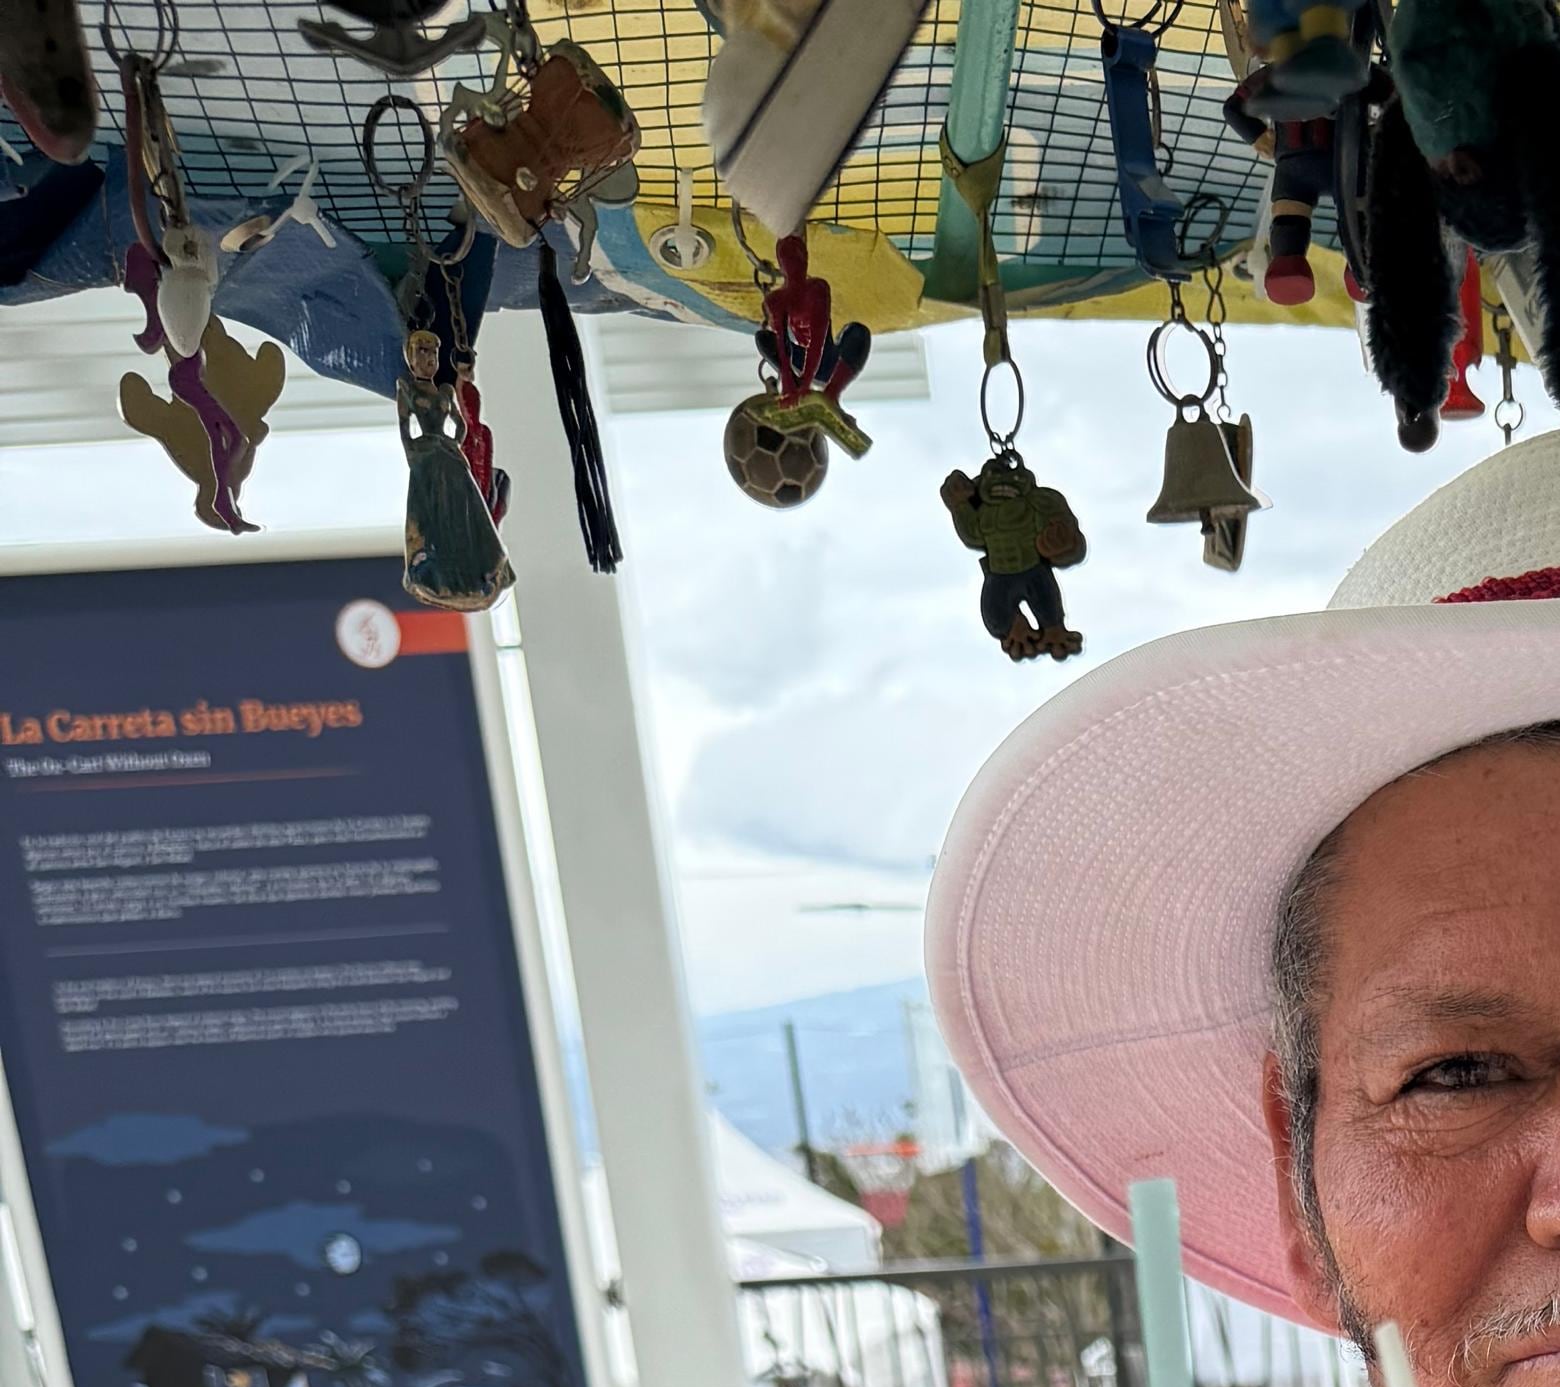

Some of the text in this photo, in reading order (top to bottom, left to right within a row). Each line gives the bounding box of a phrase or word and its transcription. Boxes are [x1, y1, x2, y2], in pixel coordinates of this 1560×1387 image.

[0, 698, 363, 745] La Carreta sin Bueyes
